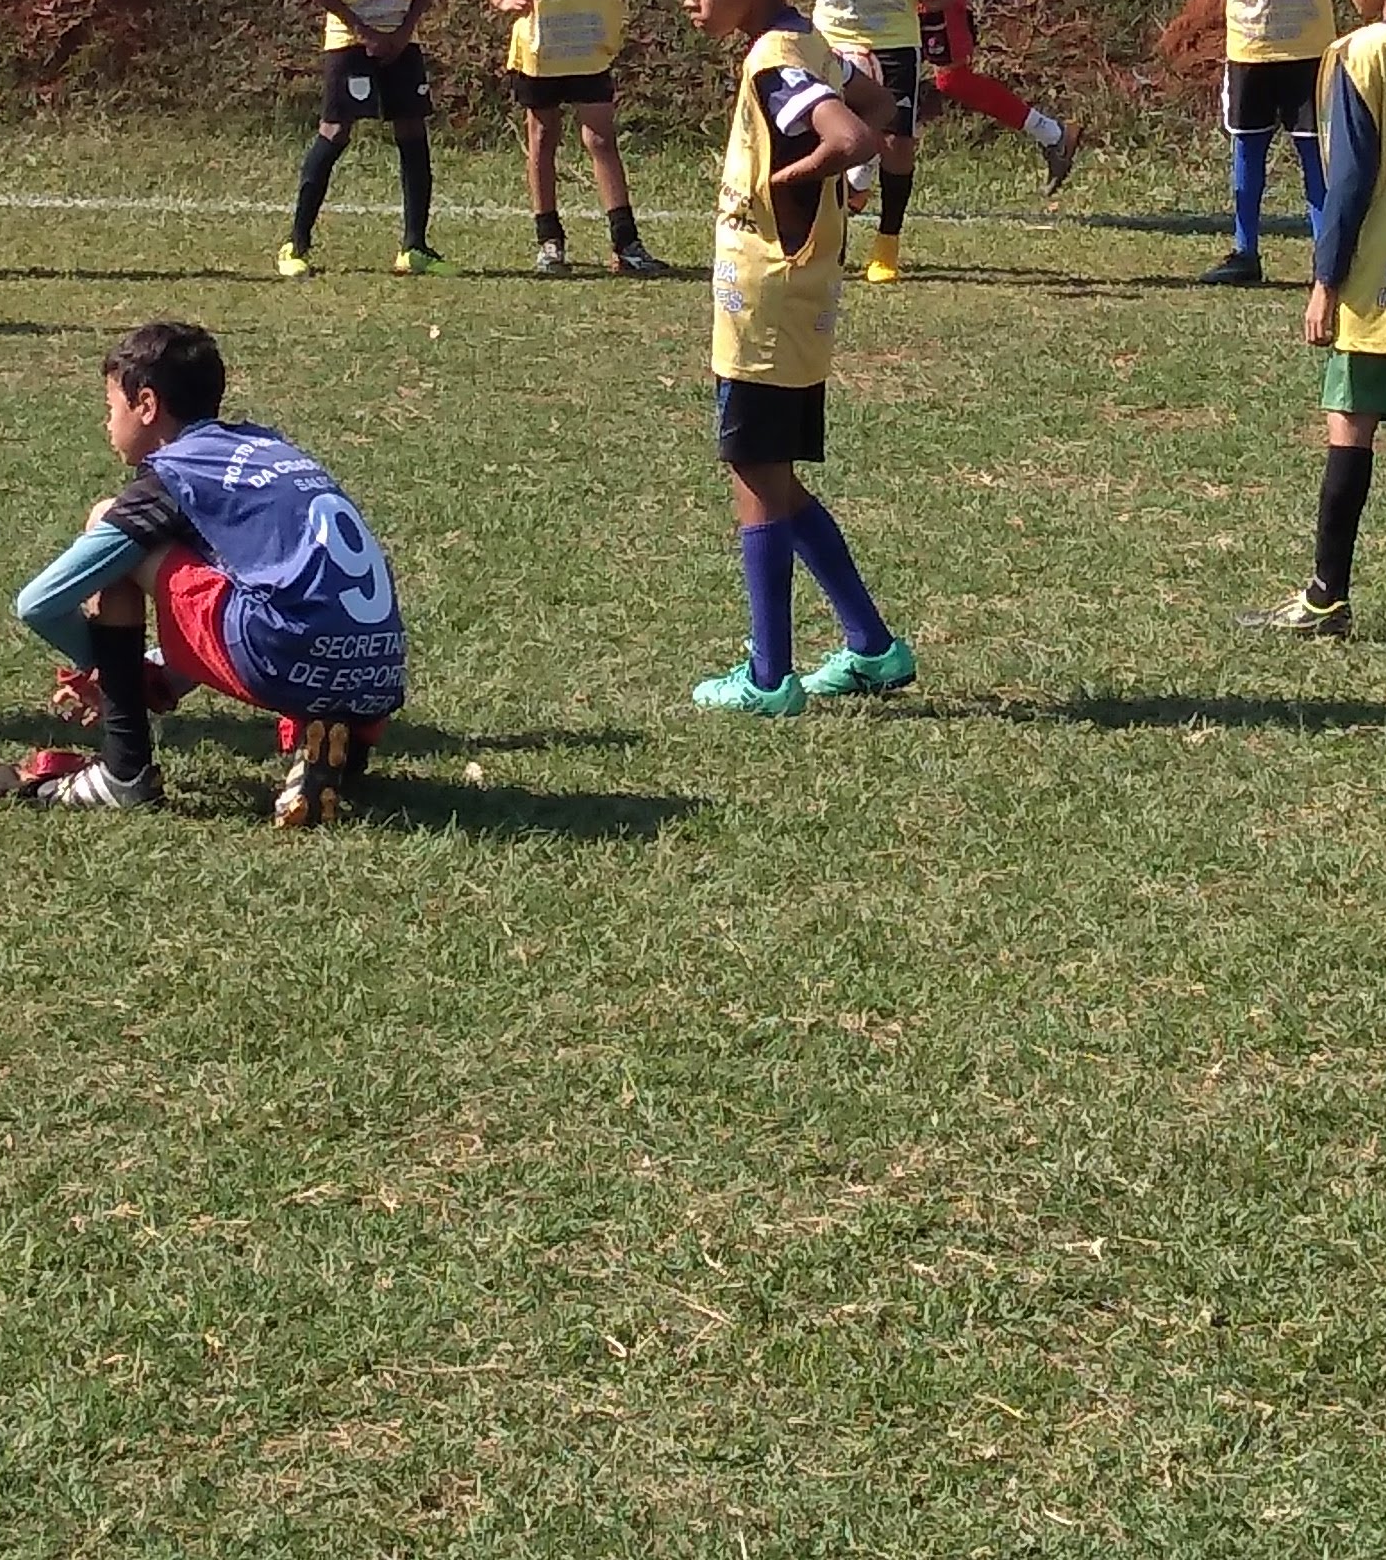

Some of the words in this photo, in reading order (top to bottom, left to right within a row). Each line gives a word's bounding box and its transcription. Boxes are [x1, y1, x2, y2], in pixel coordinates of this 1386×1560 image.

[247, 467, 278, 489] DA
[308, 492, 393, 624] 9
[288, 661, 331, 688] DE
[306, 695, 332, 715] E
